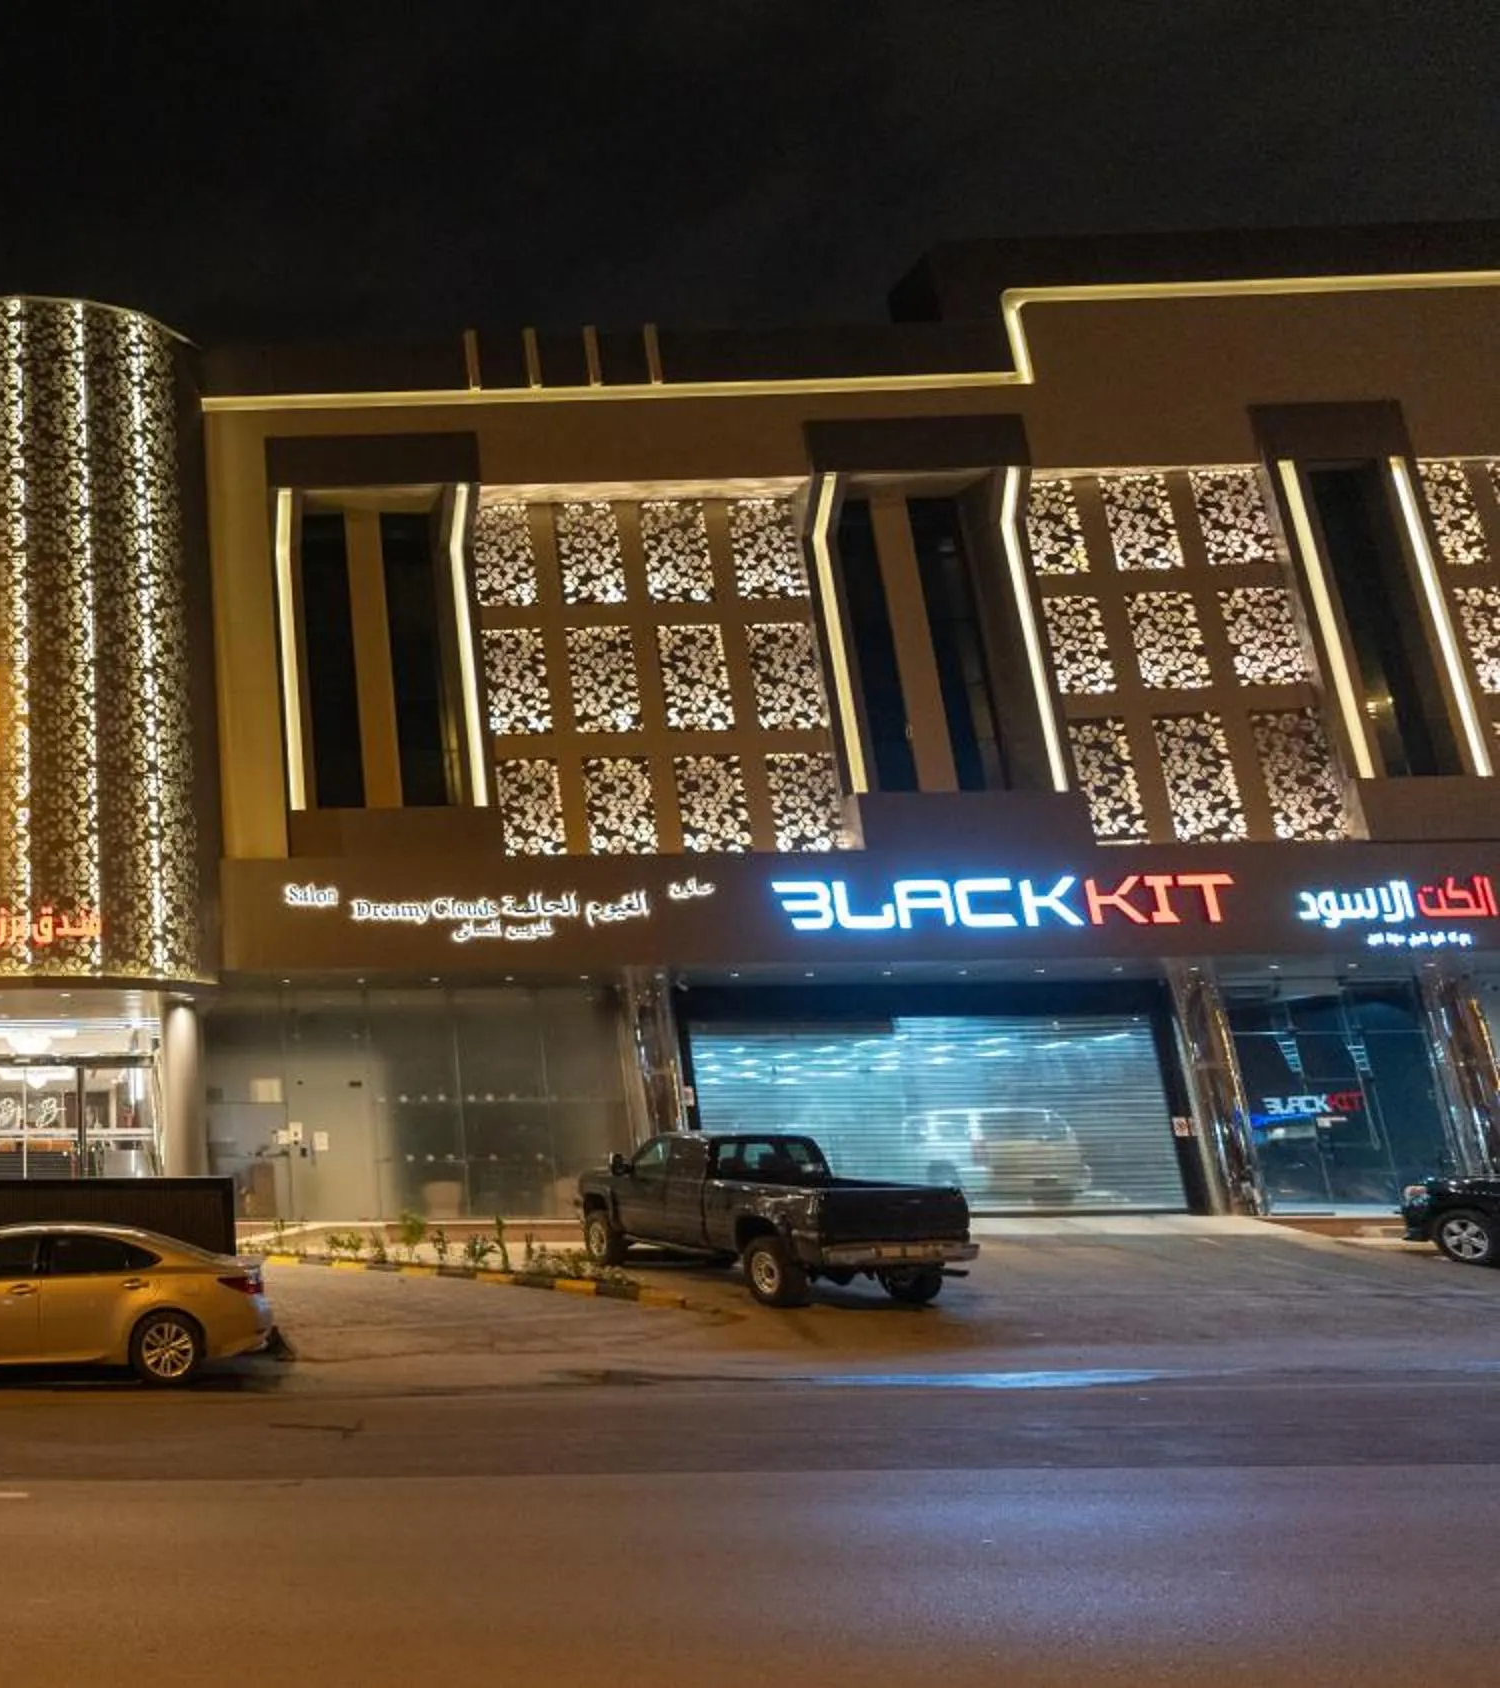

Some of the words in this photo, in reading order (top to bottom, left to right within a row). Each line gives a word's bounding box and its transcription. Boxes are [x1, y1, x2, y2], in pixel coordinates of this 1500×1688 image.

[284, 882, 339, 906] Salon
[350, 897, 431, 925] Dreamy
[431, 896, 500, 919] Clouds
